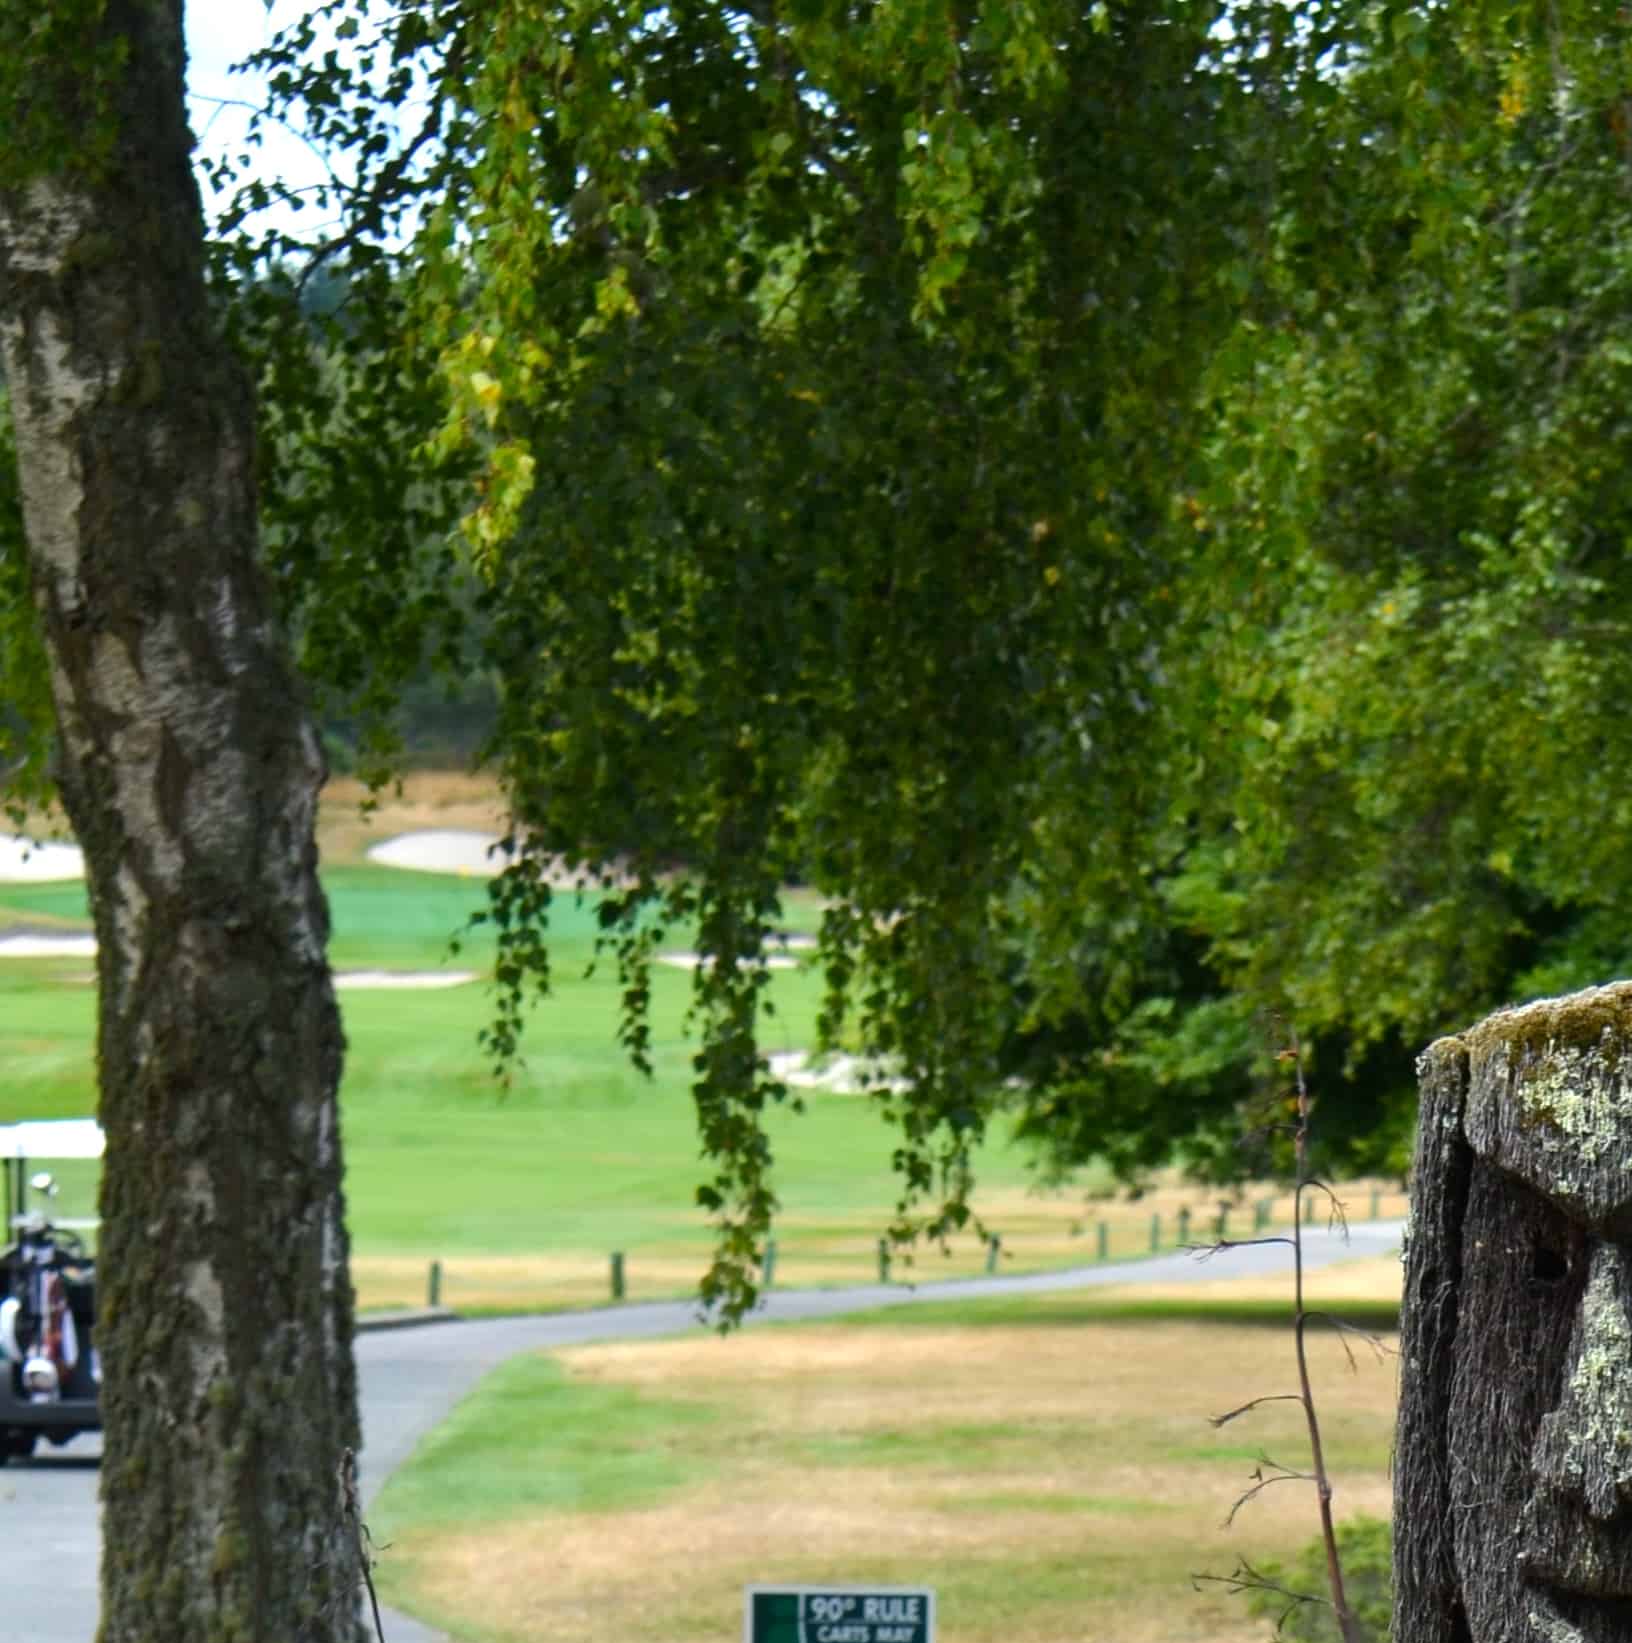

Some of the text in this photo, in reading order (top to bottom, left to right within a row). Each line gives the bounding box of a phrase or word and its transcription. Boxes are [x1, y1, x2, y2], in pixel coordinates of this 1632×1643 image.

[810, 1598, 920, 1620] 90° RULE
[817, 1626, 915, 1642] CARTS MAY
